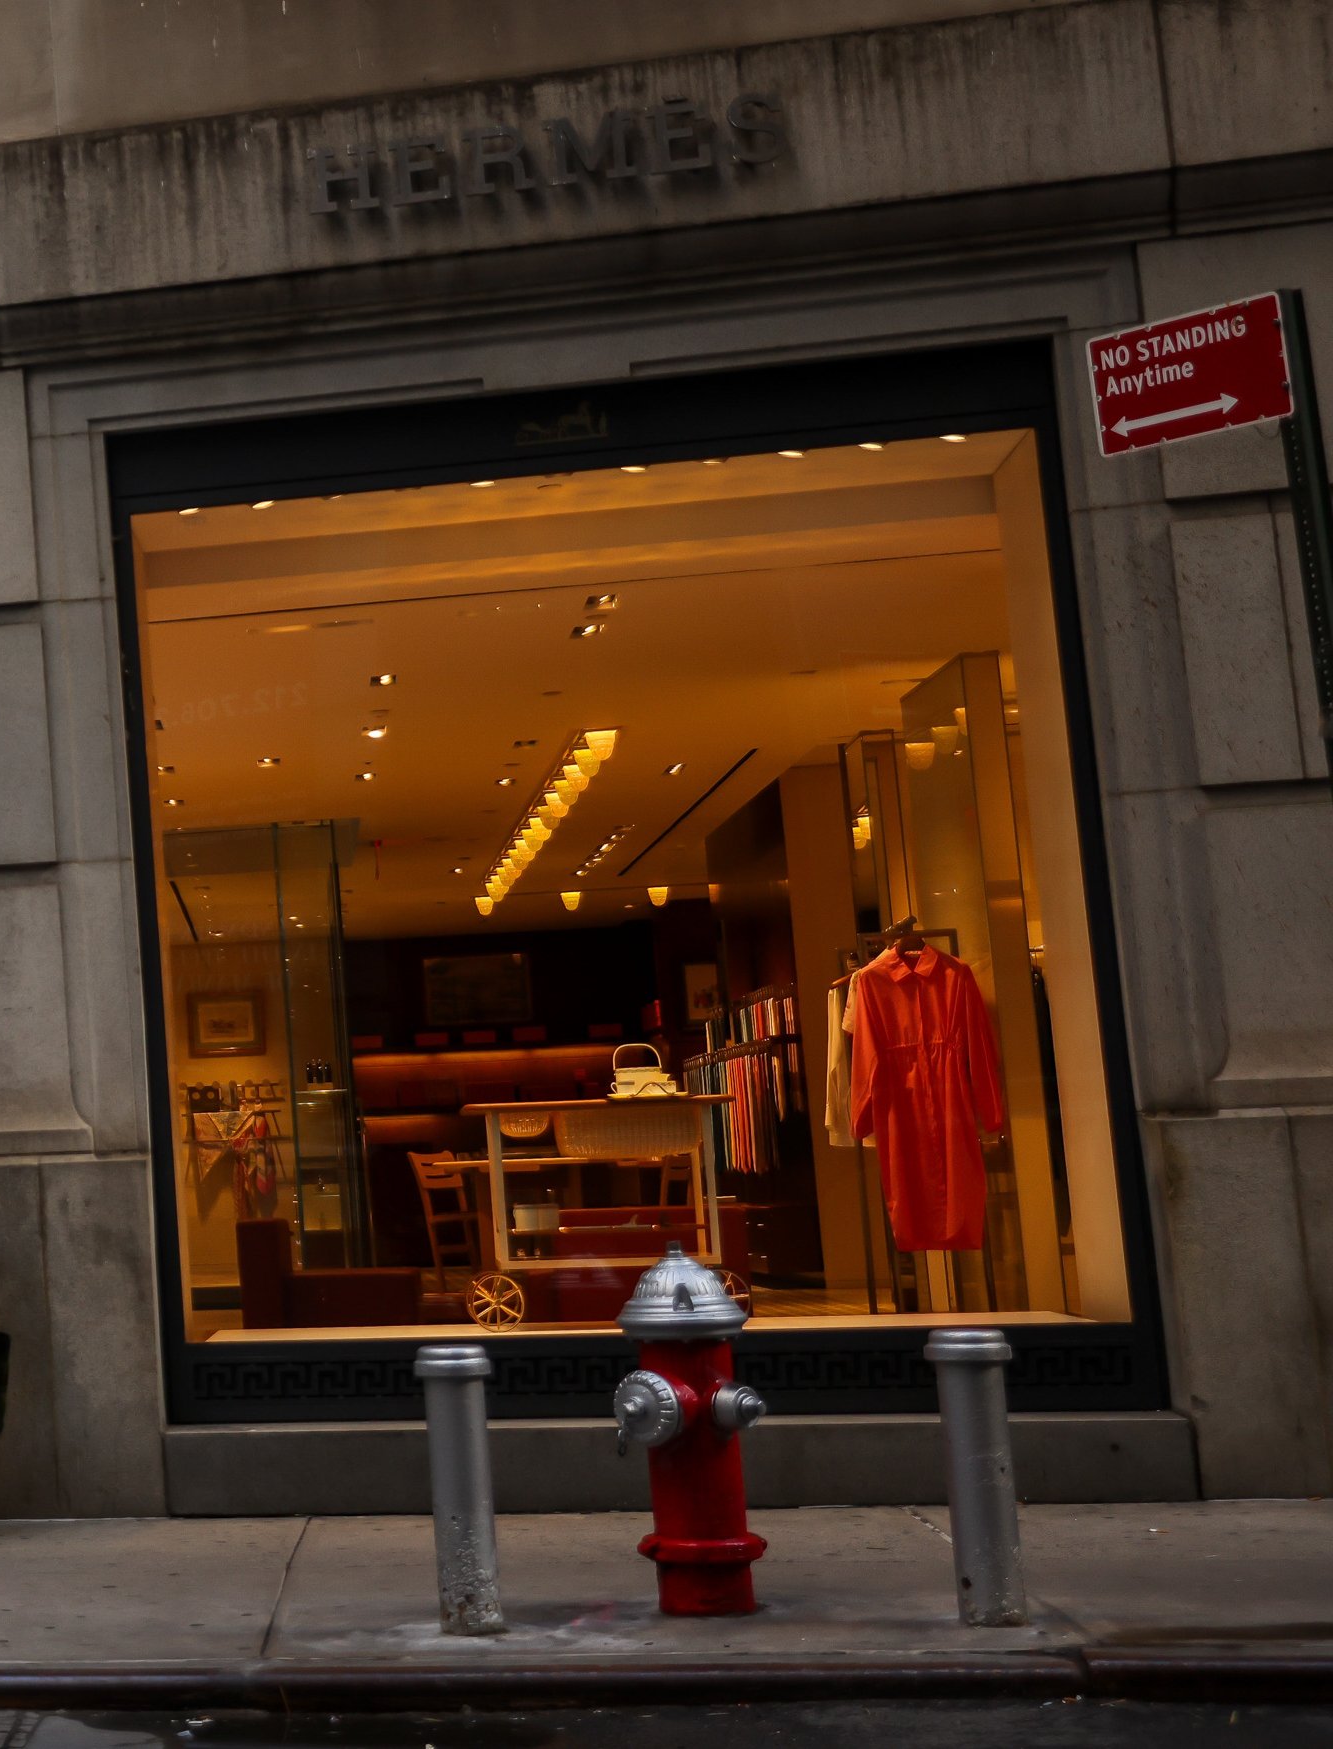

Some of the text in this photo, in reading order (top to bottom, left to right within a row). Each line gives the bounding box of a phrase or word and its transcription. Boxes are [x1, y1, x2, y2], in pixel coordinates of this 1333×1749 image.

[1100, 315, 1246, 371] NO STANDING
[1106, 361, 1194, 398] Anytime
